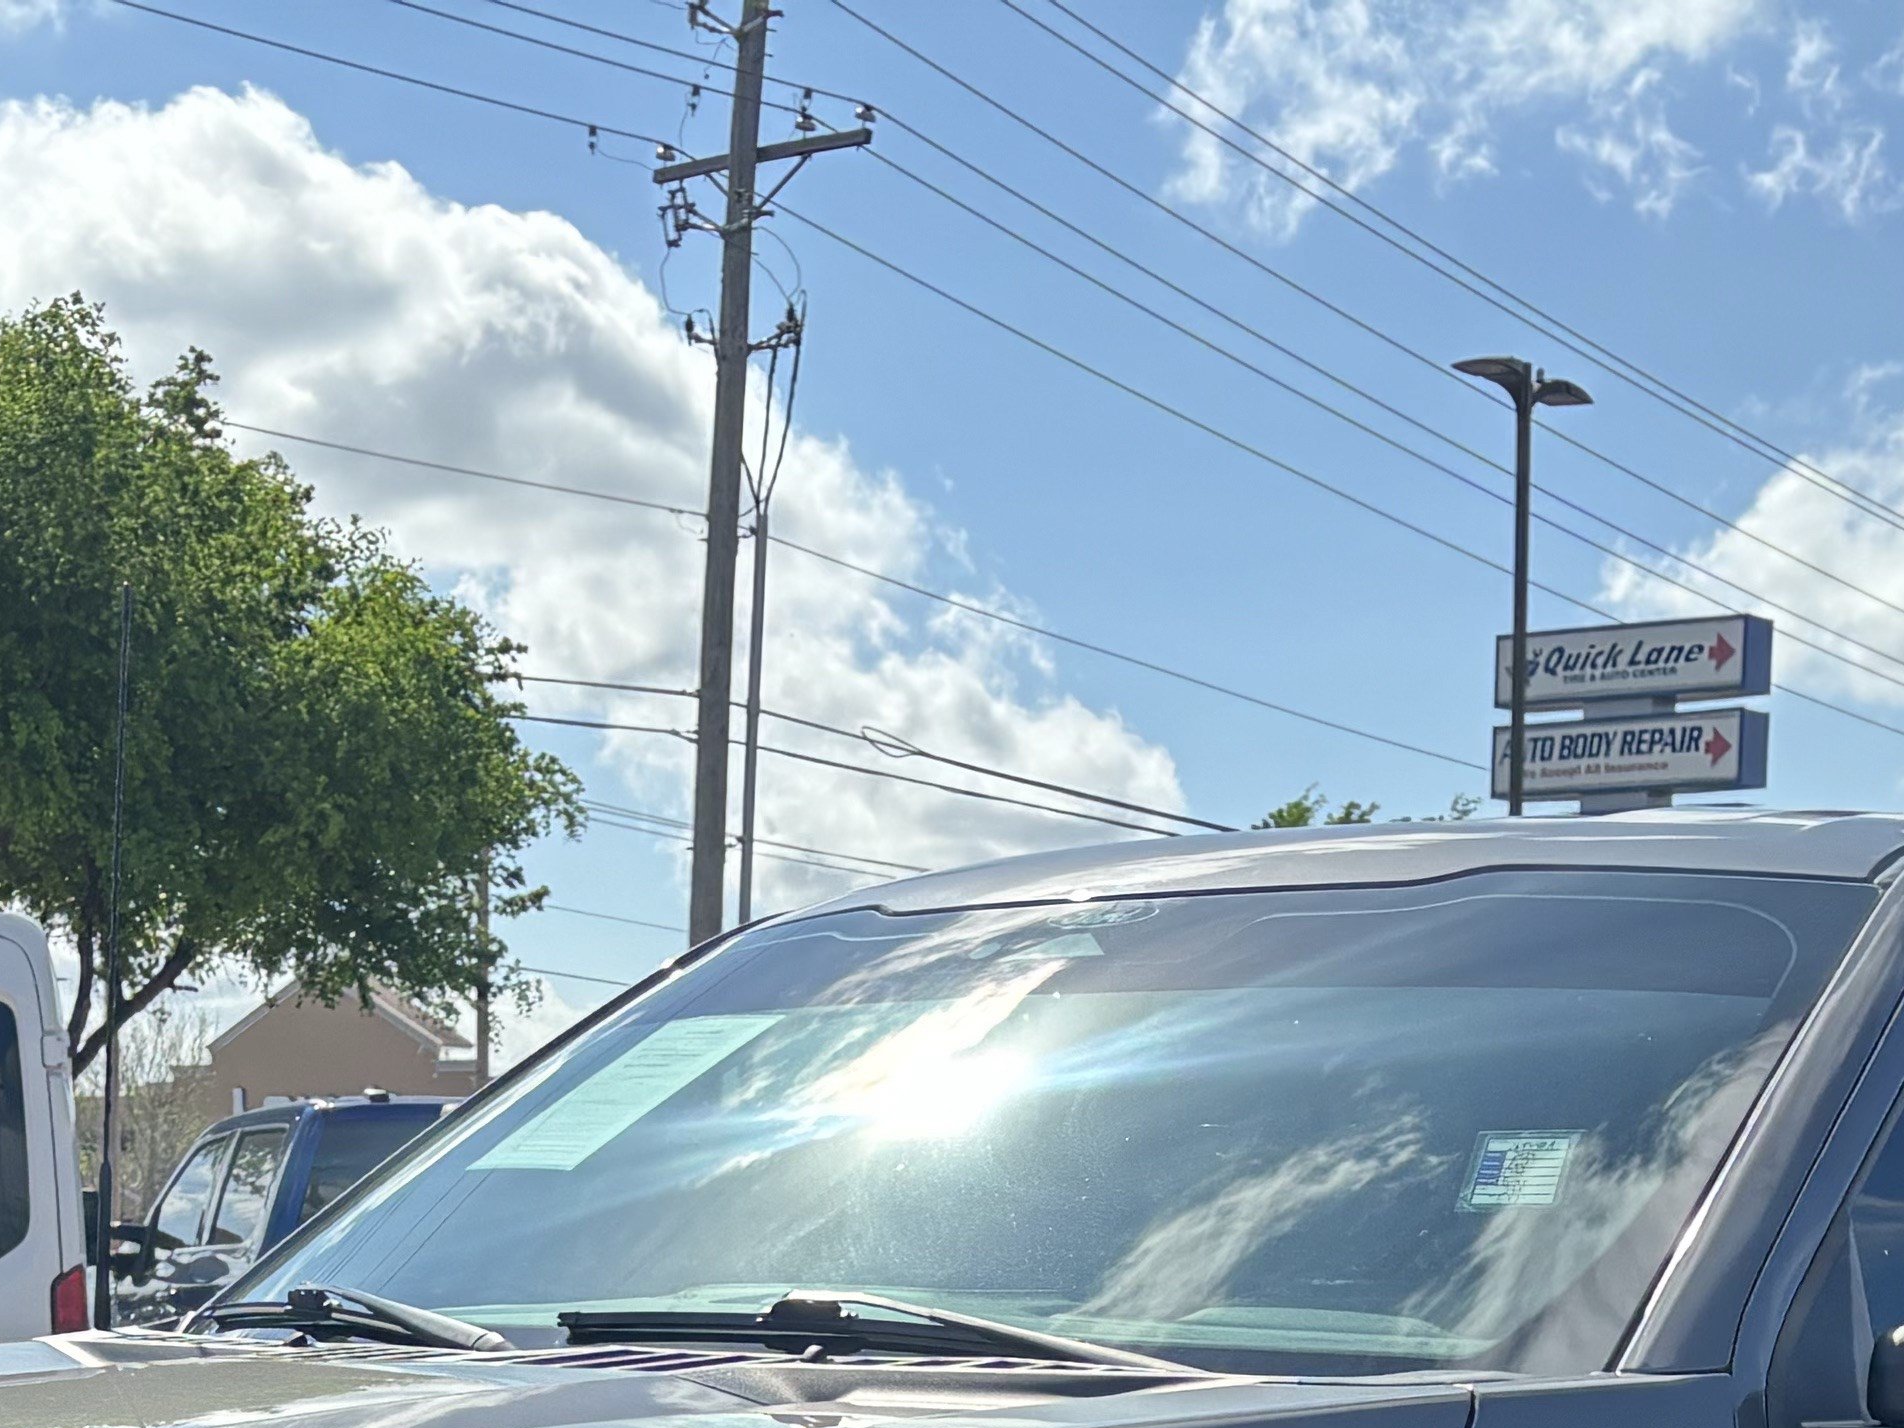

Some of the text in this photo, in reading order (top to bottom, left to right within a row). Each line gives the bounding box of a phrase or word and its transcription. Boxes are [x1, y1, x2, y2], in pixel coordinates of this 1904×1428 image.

[1543, 639, 1705, 677] Quick Lane
[1600, 670, 1630, 681] AUTO
[1632, 666, 1678, 678] CENTER
[1558, 731, 1618, 760] BODY
[1619, 725, 1704, 757] REPAIR
